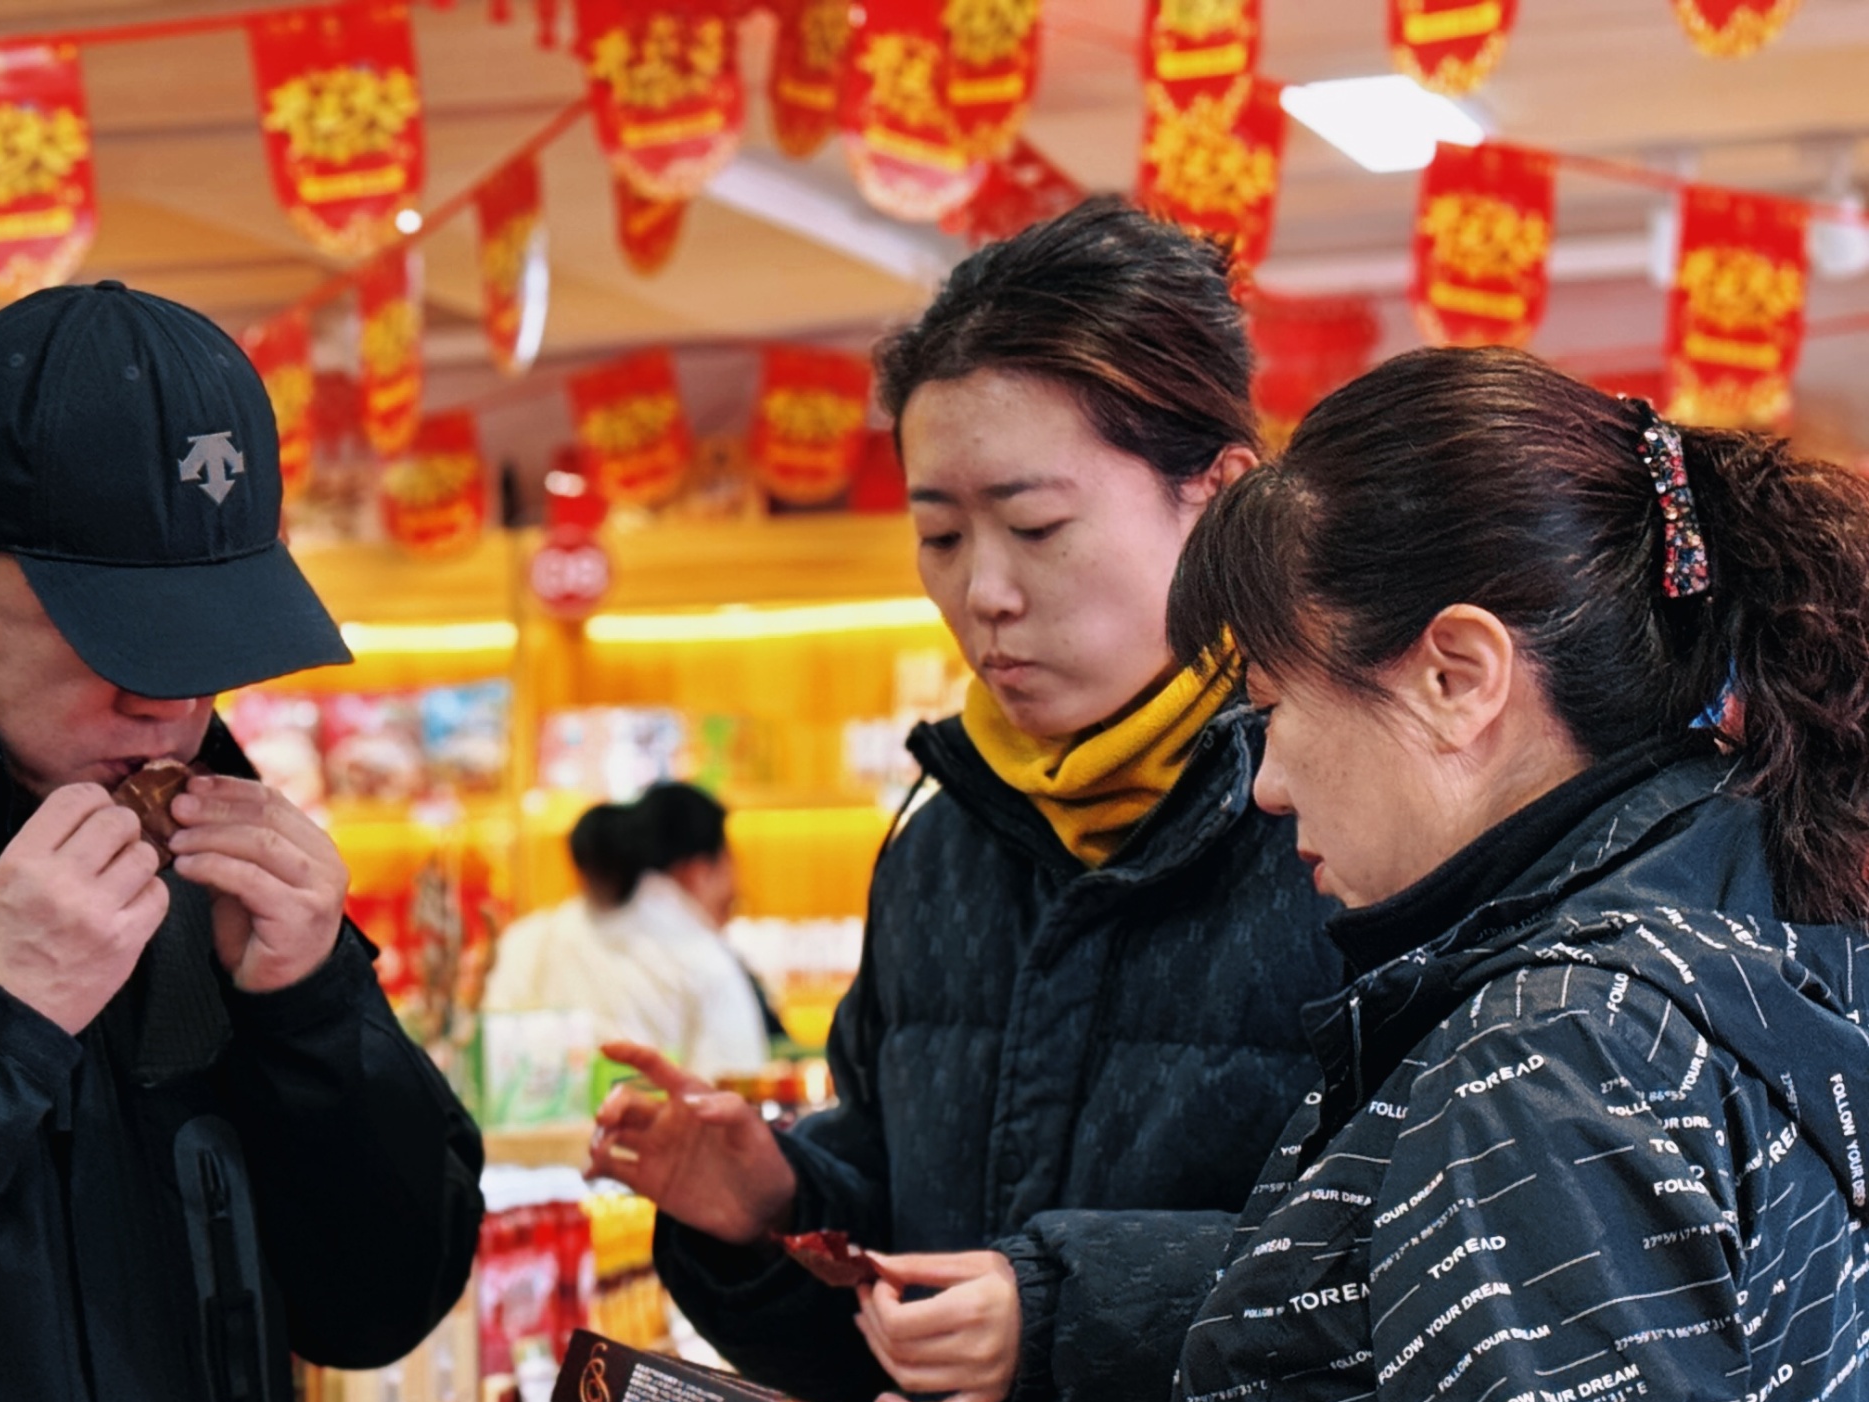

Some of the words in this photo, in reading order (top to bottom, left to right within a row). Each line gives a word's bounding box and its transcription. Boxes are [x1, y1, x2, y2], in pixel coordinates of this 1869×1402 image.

[1455, 1054, 1545, 1098] TOREAD
[1830, 1073, 1856, 1136] FOLLOW
[1374, 1202, 1410, 1228] YOUR
[1427, 1236, 1507, 1279] TOREAD
[1289, 1282, 1371, 1314] TOREA
[1378, 1335, 1426, 1385] FOLLOW
[1425, 1304, 1463, 1339] YOUR
[1460, 1282, 1513, 1311] DREAM
[1437, 1352, 1474, 1394] FOLLOW
[1472, 1328, 1512, 1356] YOUR
[1576, 1363, 1641, 1398] DREAM
[1636, 1381, 1649, 1396] E
